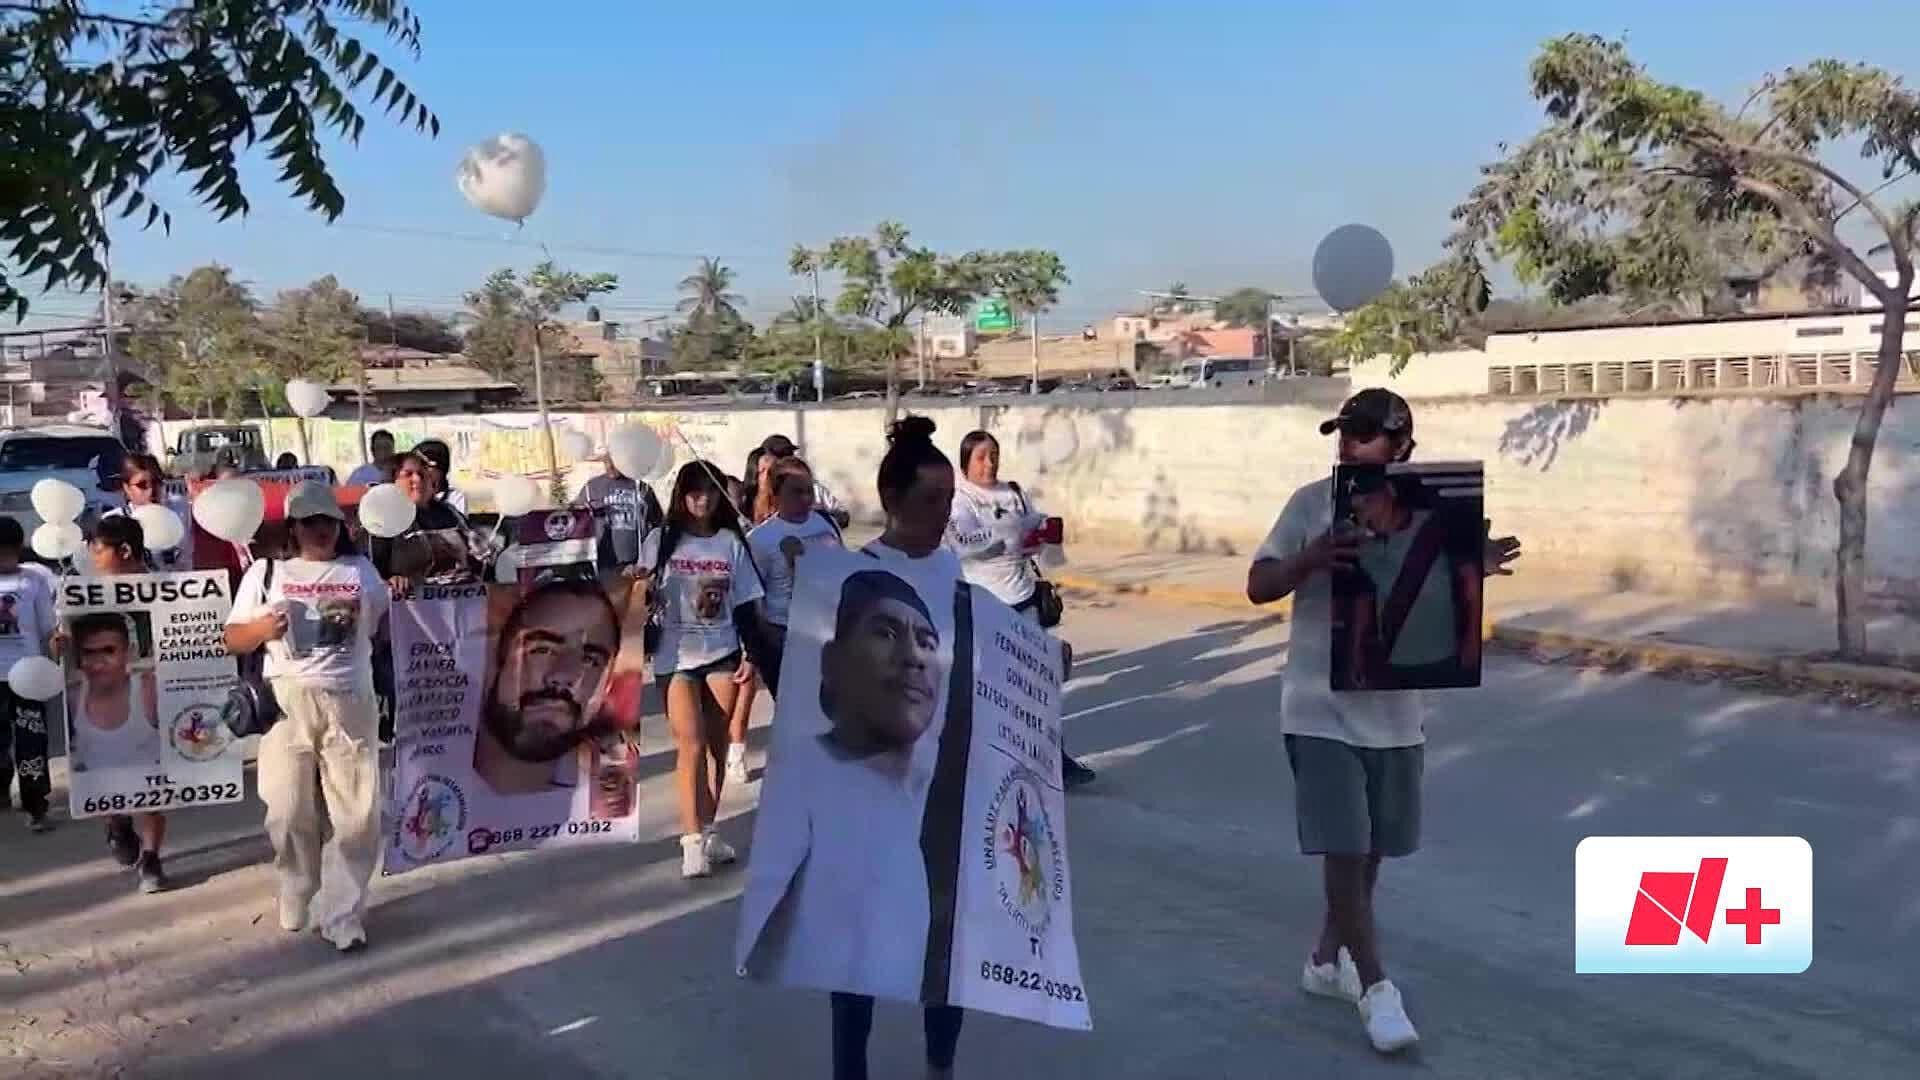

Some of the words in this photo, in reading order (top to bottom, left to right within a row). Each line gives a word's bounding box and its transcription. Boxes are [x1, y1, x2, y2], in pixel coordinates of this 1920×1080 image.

[64, 584, 105, 606] SE
[114, 578, 224, 604] BUSCA
[170, 611, 217, 624] EDWIN
[160, 636, 227, 650] CAMACH
[160, 649, 230, 662] AHUMAD
[84, 783, 241, 813] 668-227-0392
